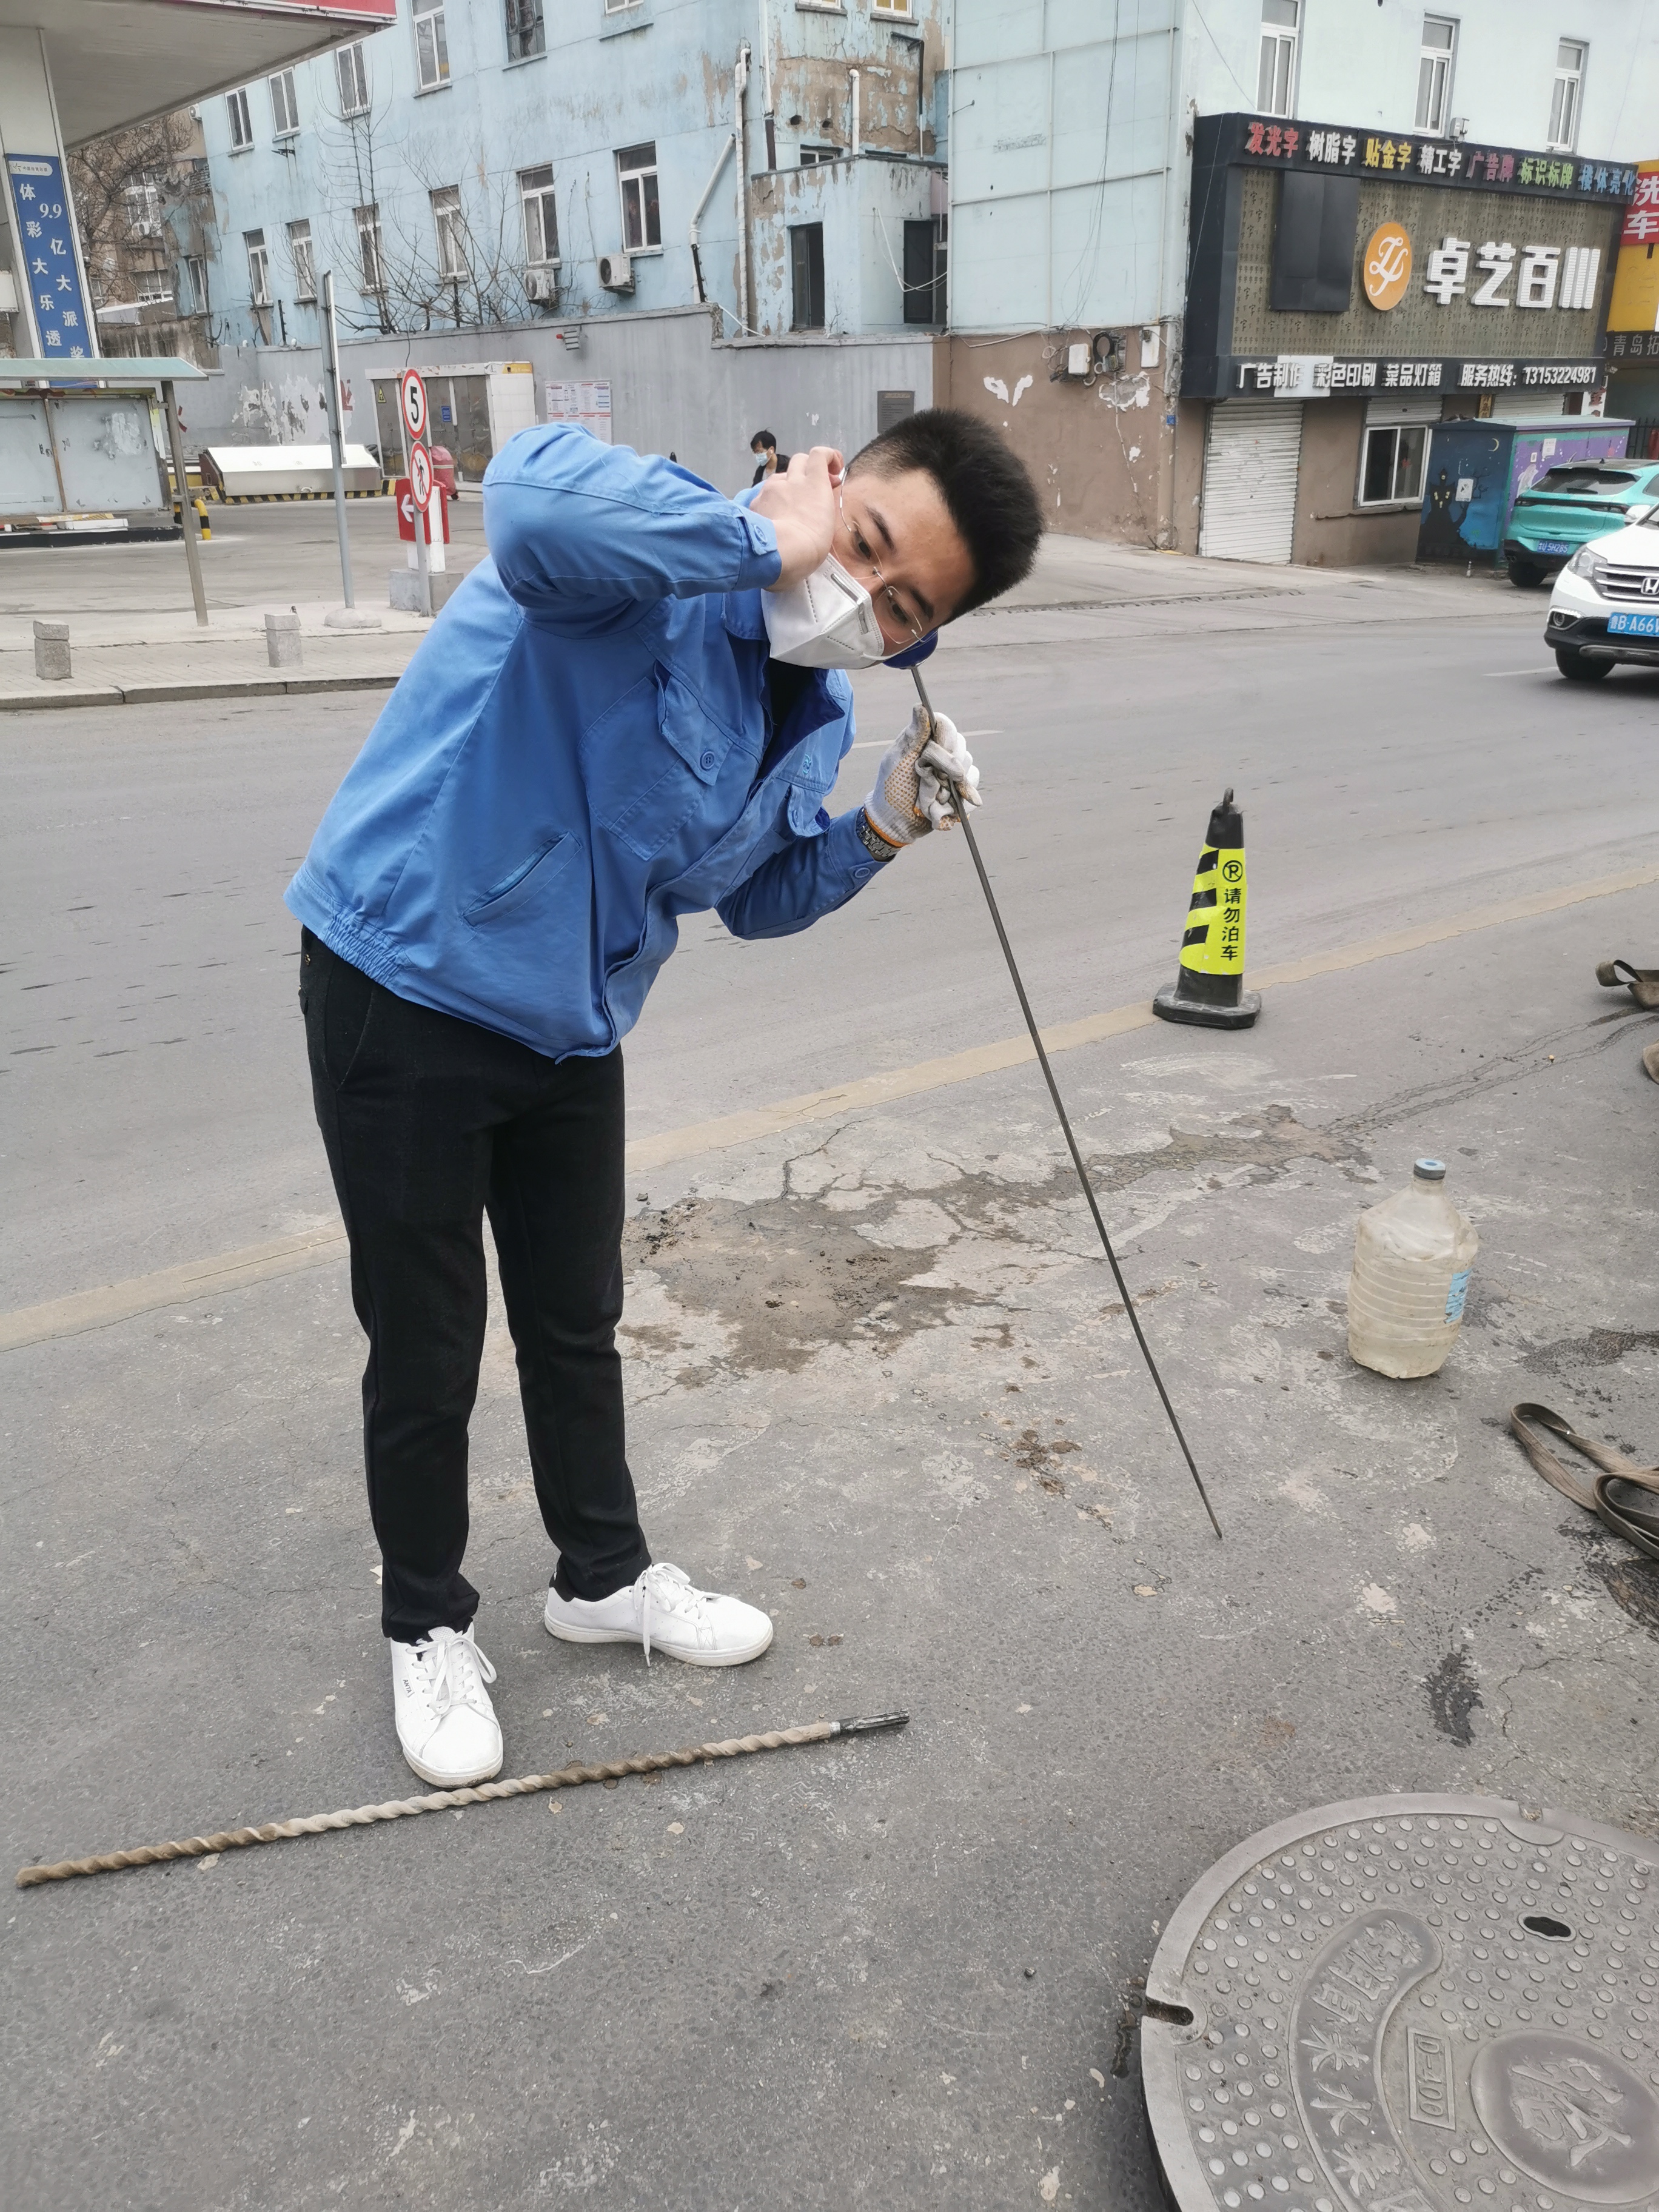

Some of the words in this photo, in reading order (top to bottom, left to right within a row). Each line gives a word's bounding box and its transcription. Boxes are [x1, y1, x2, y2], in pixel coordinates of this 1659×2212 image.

[1248, 122, 1298, 158] 发光字
[1307, 130, 1356, 165] 树脂字
[1364, 138, 1412, 170] 贴金字
[1419, 144, 1462, 177] 精工字
[1466, 151, 1515, 182] 广告牌
[1518, 156, 1574, 189] 标识标牌
[1578, 164, 1635, 196] 楼体亮化
[1623, 175, 1659, 240] 洗车
[19, 183, 62, 346] 体彩大乐透
[1423, 237, 1601, 309] 卓艺百川
[410, 386, 419, 424] 5
[1239, 363, 1304, 389] 广告制作
[1315, 363, 1377, 387] 彩色印刷
[1384, 363, 1442, 387] 菜品灯箱
[1523, 366, 1597, 384] 13153224981
[1220, 887, 1242, 962] 请勿泊车
[1416, 2037, 1444, 2116] D-400
